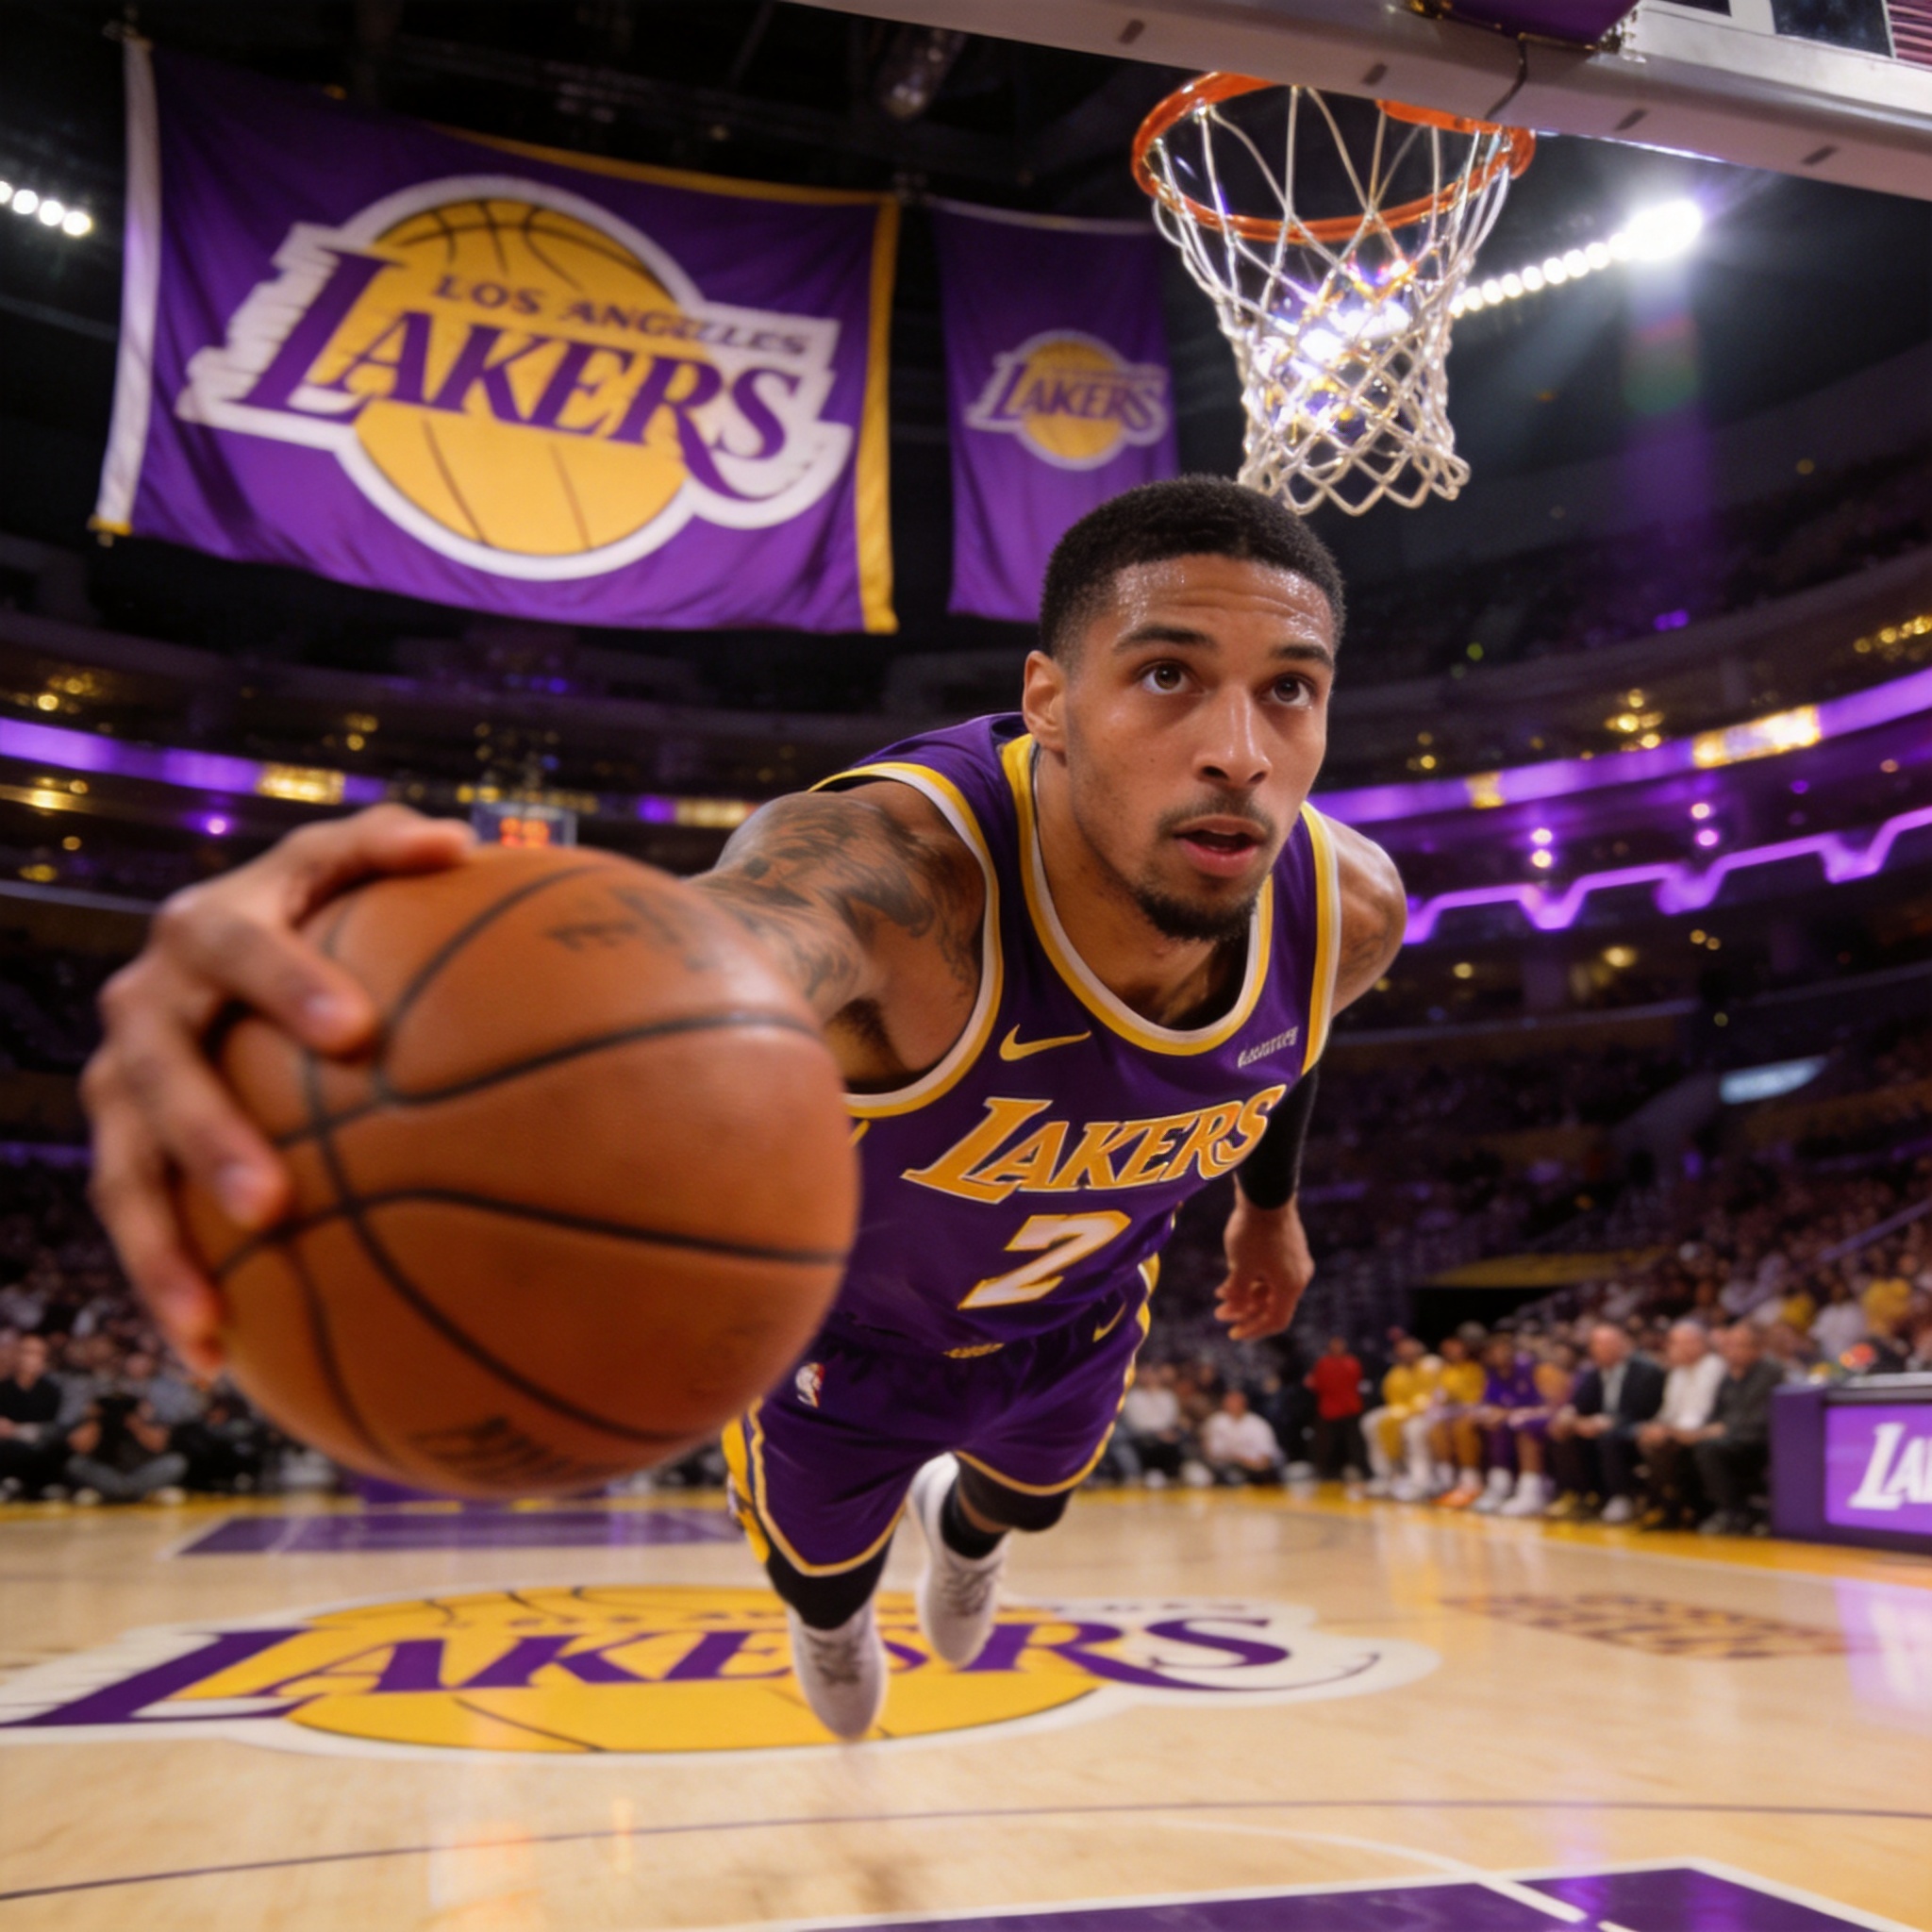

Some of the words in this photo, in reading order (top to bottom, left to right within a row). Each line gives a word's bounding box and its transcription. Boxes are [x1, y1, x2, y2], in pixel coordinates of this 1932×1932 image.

[431, 275, 544, 317] LOS
[225, 247, 817, 501] LAKERS
[987, 361, 1160, 431] LAKERS
[899, 1084, 1287, 1205] LAKERS
[957, 1209, 1132, 1311] 2
[1845, 1421, 1932, 1511] LA
